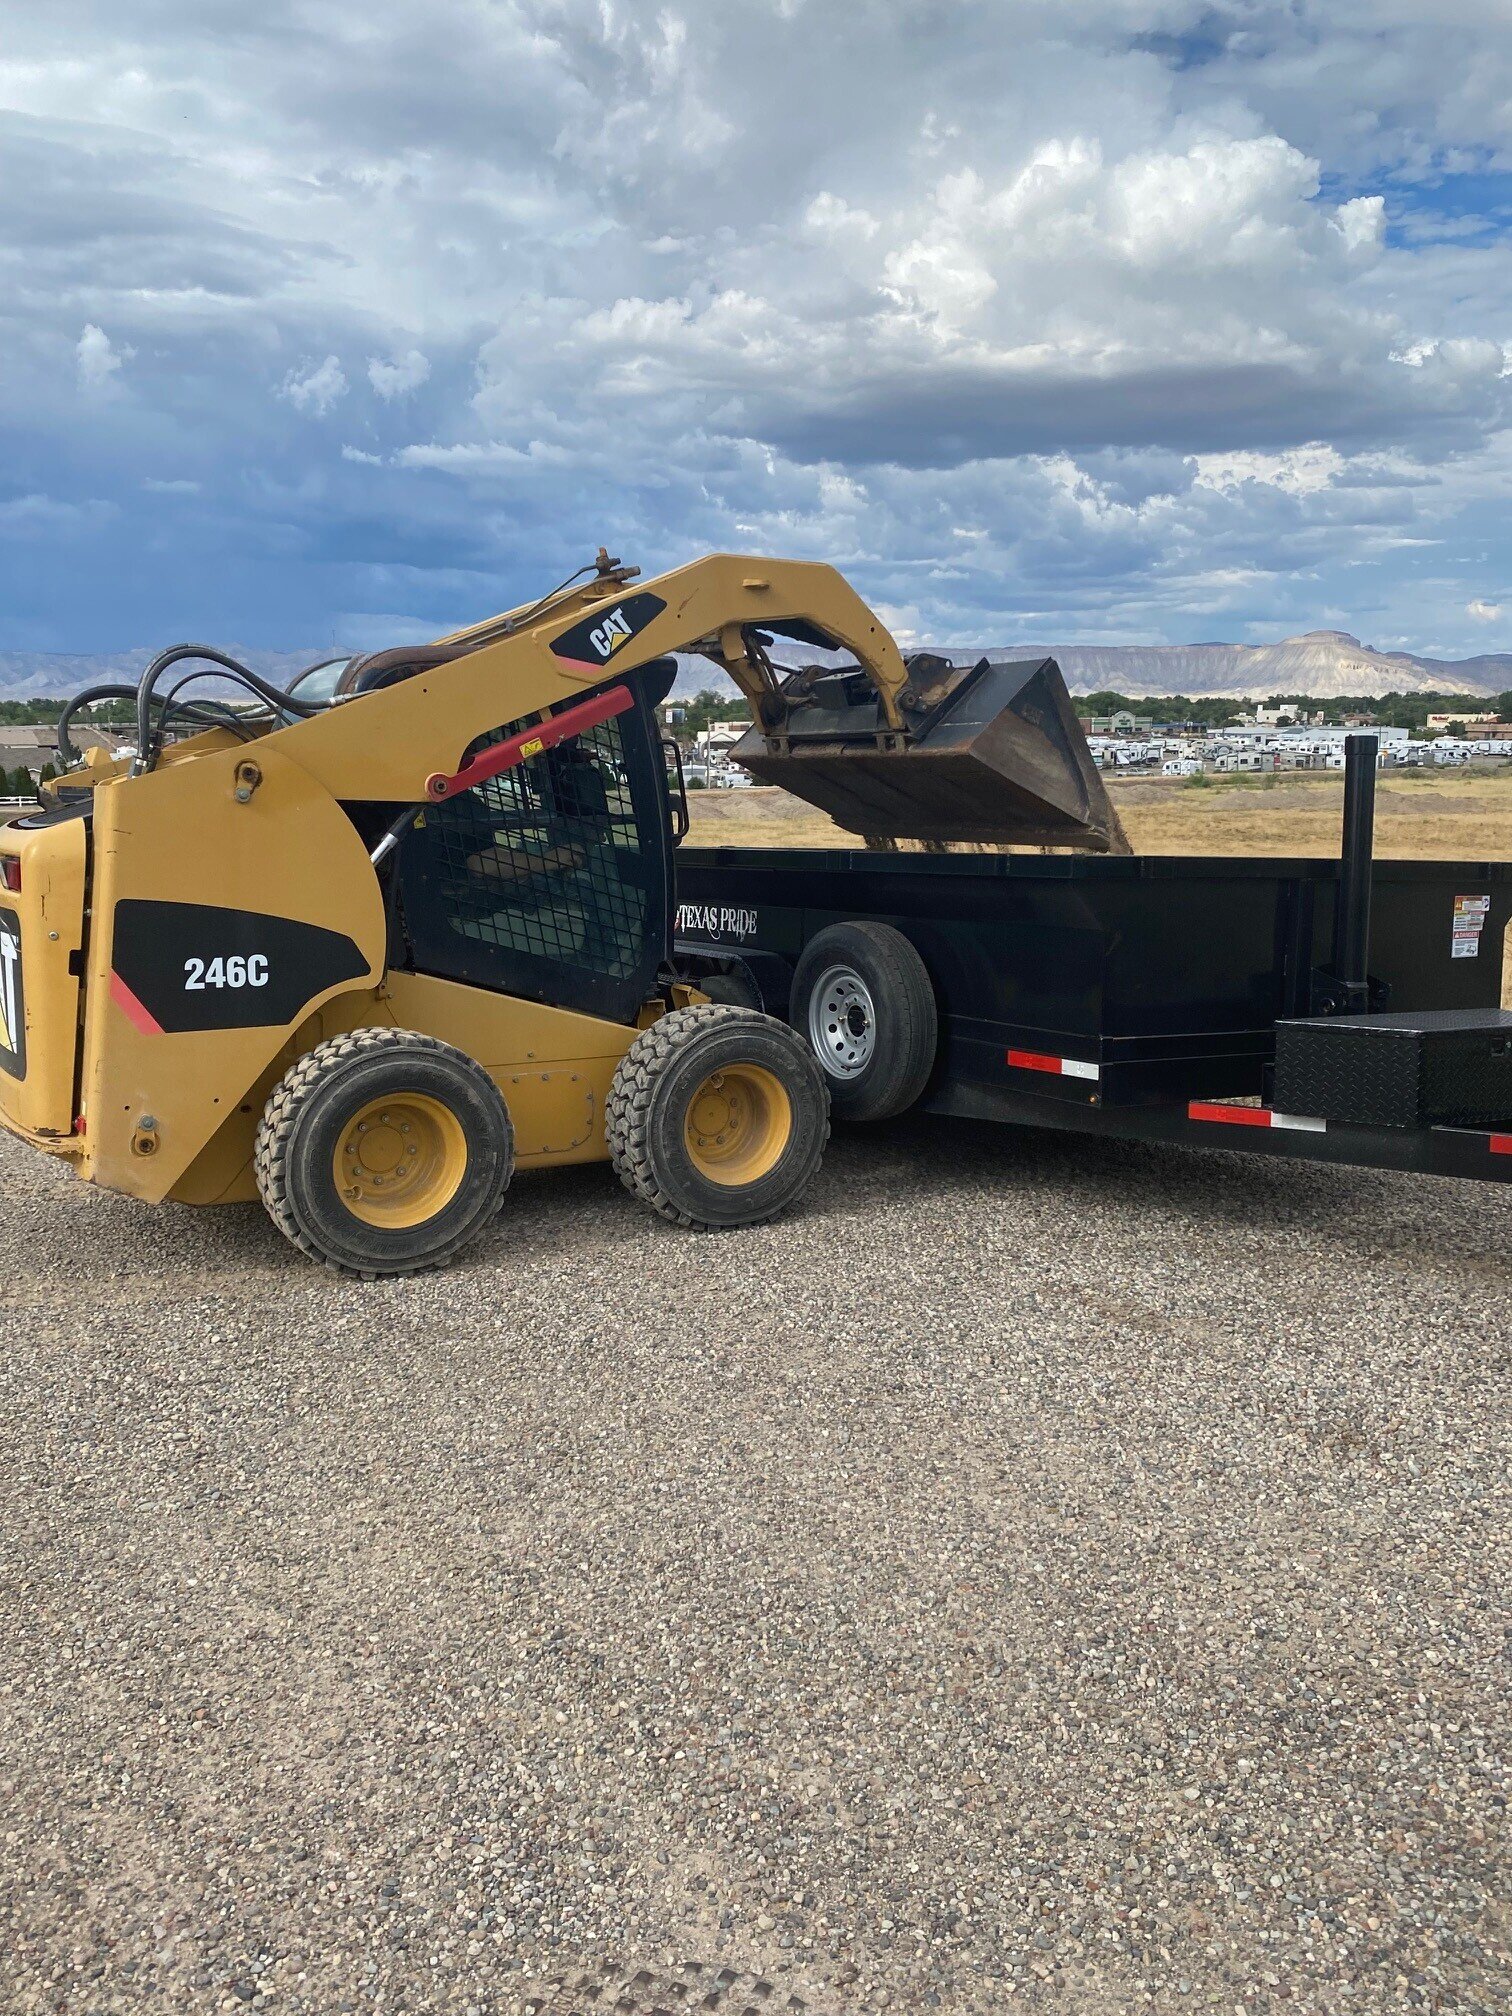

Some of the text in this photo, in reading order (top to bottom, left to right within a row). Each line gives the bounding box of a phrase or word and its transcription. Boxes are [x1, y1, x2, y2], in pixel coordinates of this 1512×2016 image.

[589, 607, 633, 657] CAT
[679, 904, 758, 941] TEXAS PRIDE
[184, 954, 269, 990] 246C
